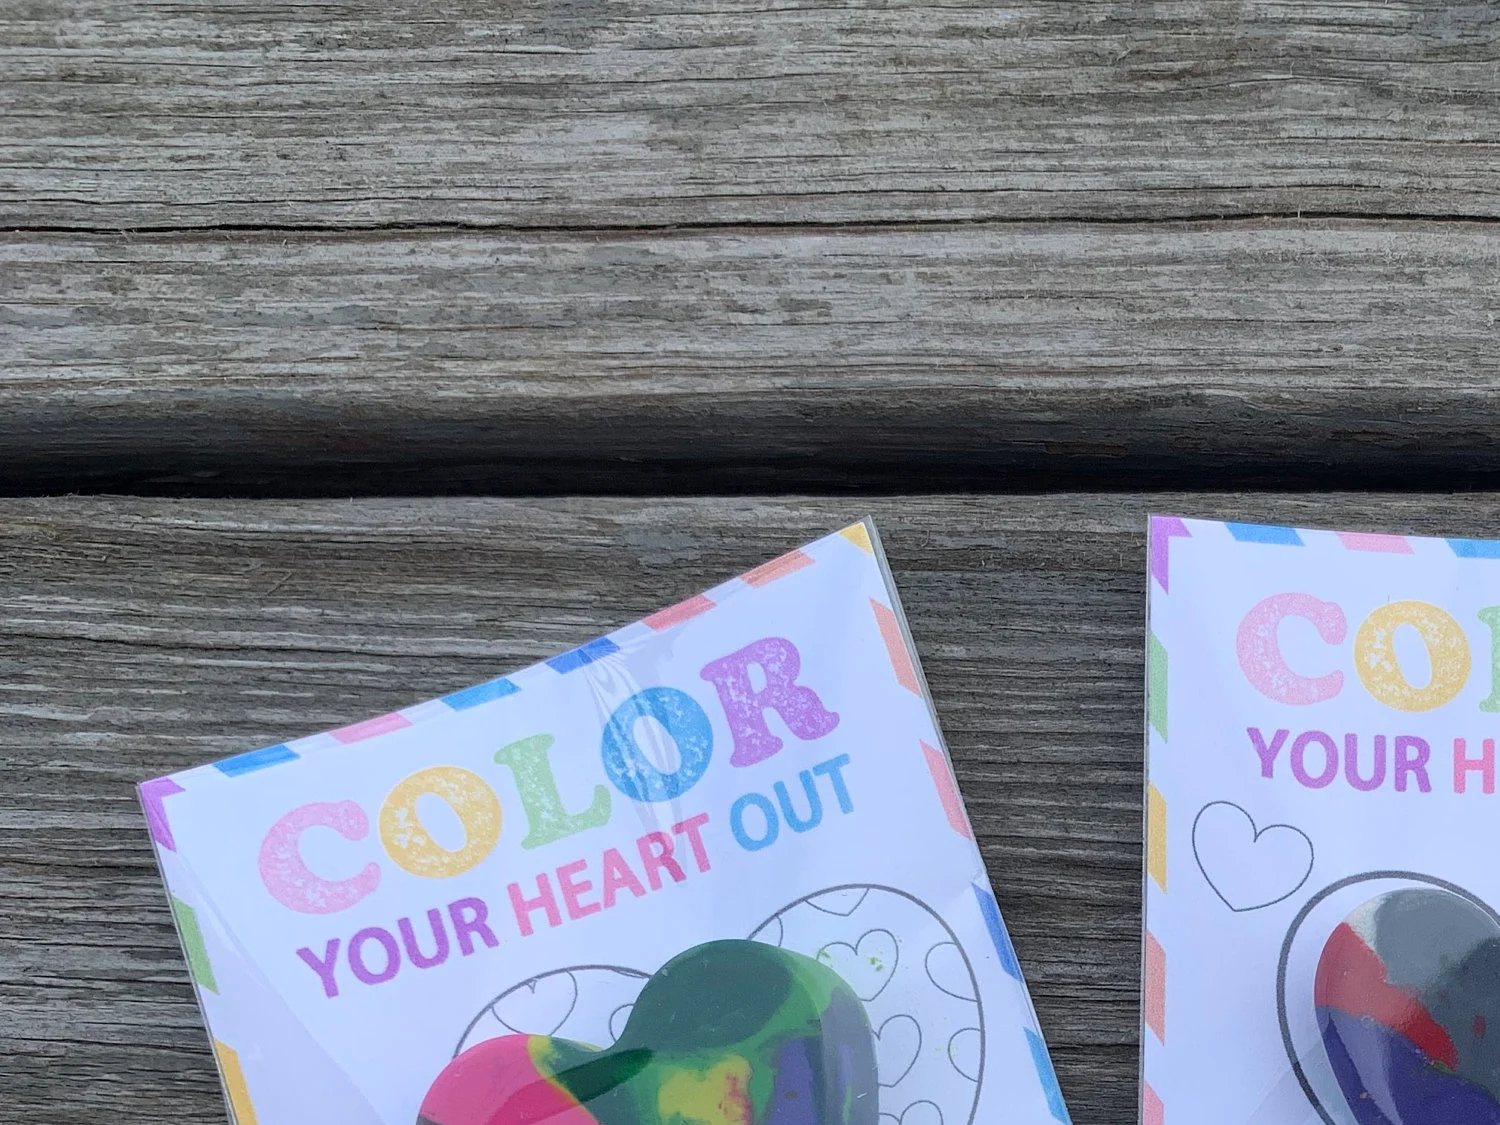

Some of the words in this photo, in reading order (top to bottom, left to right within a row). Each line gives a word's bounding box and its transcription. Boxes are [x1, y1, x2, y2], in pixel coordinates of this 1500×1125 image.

[259, 637, 840, 915] COLOR
[297, 896, 499, 997] YOUR
[509, 814, 715, 937] HEART
[729, 753, 853, 851] OUT
[1247, 727, 1431, 793] YOUR
